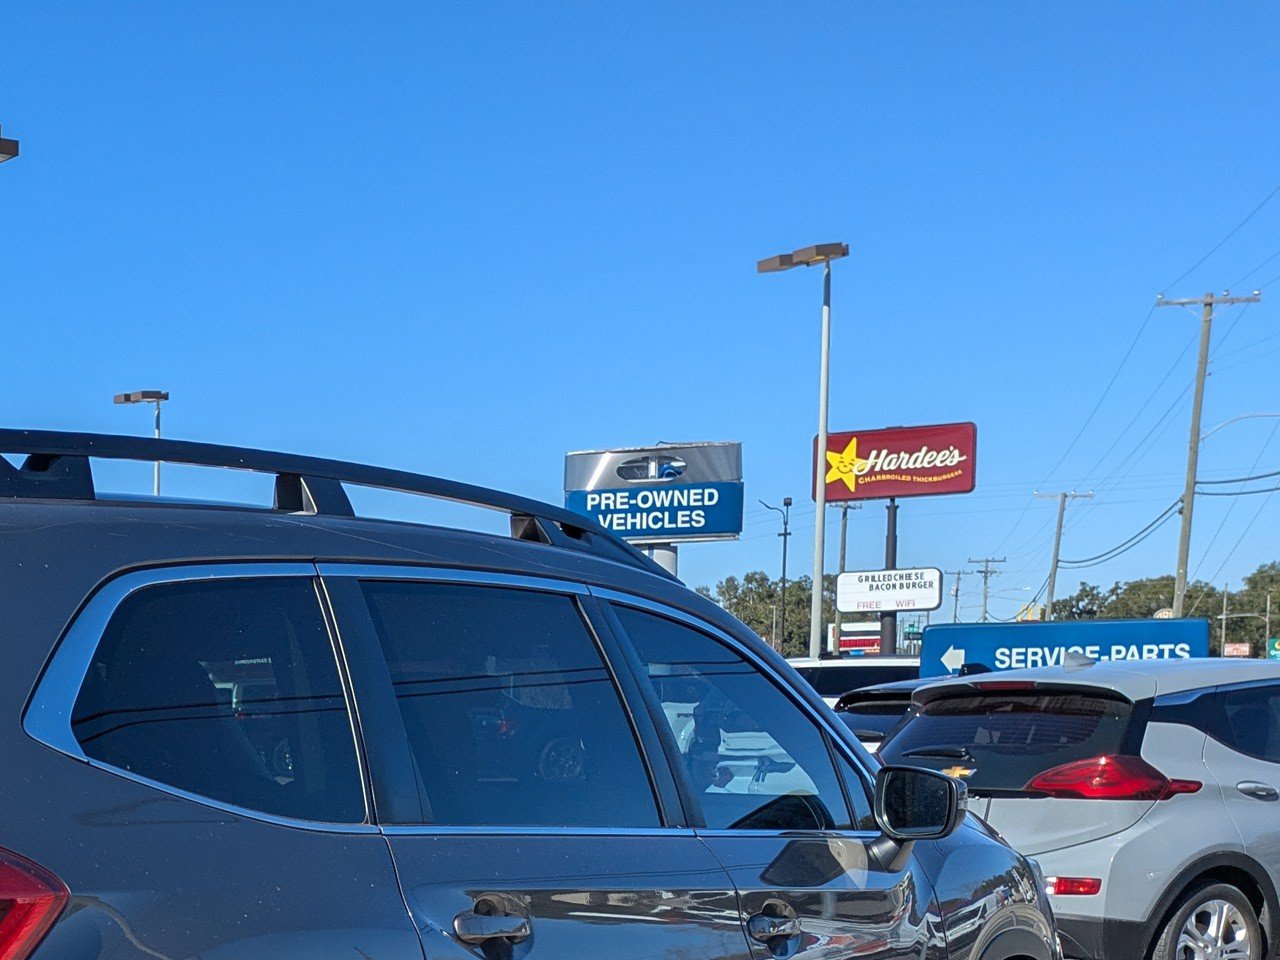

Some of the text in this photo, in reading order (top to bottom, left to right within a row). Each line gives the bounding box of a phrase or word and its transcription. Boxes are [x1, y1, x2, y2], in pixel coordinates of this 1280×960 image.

[851, 445, 967, 475] Hardee's
[586, 488, 719, 511] PRE-OWNED
[598, 509, 706, 531] VEHICLES
[868, 581, 934, 592] BACON BURGER
[856, 601, 882, 610] FREE
